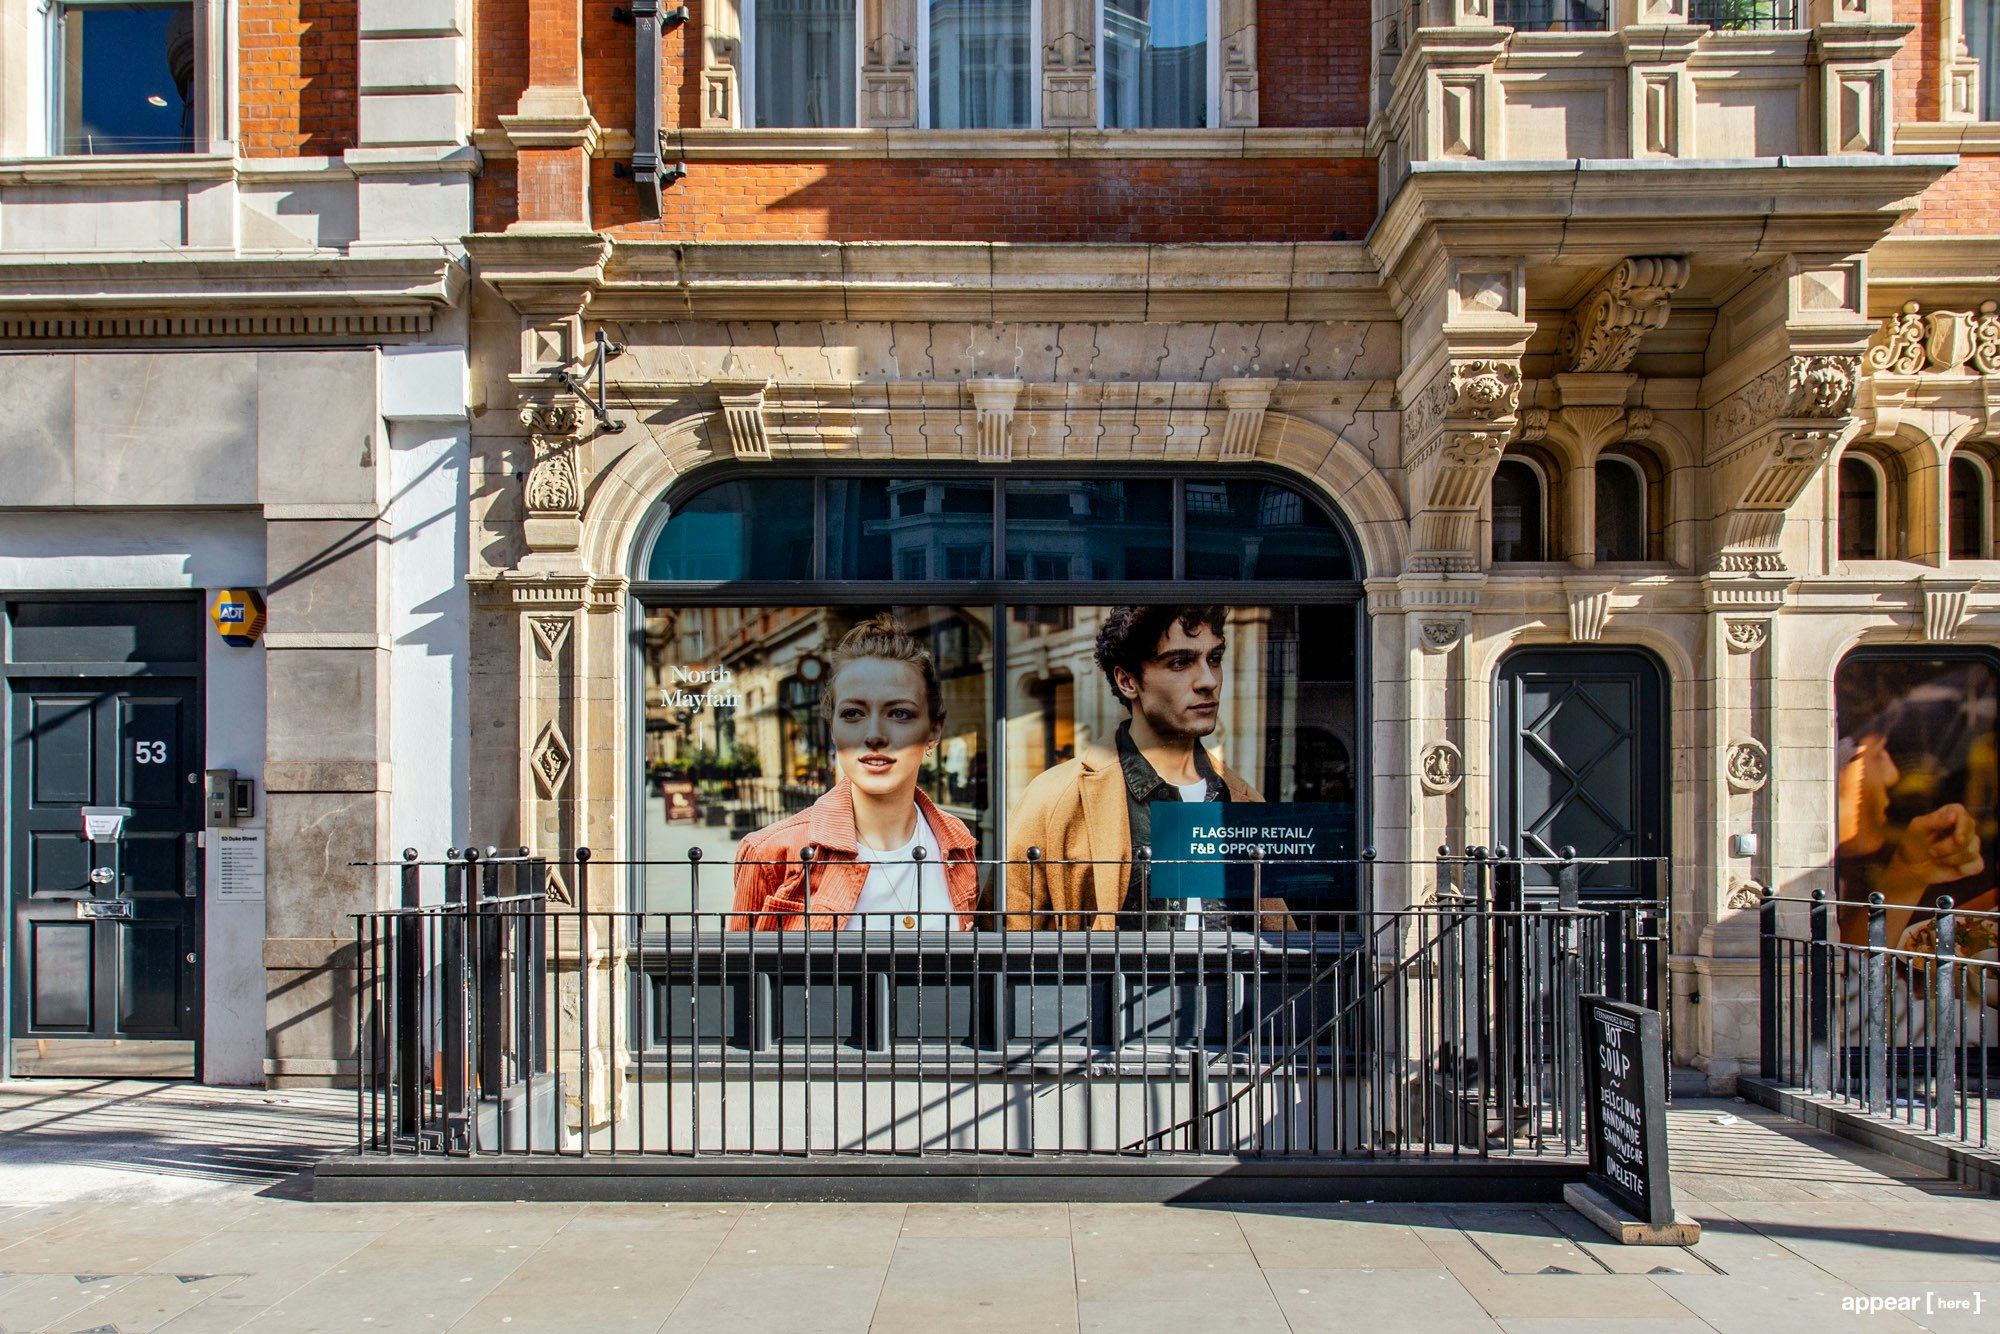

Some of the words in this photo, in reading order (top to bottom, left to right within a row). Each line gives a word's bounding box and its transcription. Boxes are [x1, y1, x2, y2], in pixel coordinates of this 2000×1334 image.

[220, 607, 244, 619] ADT
[670, 664, 733, 683] North
[660, 689, 742, 713] Mayfair
[135, 741, 167, 764] 53
[1192, 827, 1258, 838] FLAGSHIP
[1261, 827, 1314, 838] RETAIL/
[1190, 843, 1216, 854] F&B
[1605, 1023, 1622, 1049] HOT
[1599, 1044, 1630, 1079] SOUP
[1600, 1086, 1641, 1126] DELICIOUS
[1602, 1106, 1641, 1146] HANDMADE
[1606, 1155, 1644, 1196] OMELETTE
